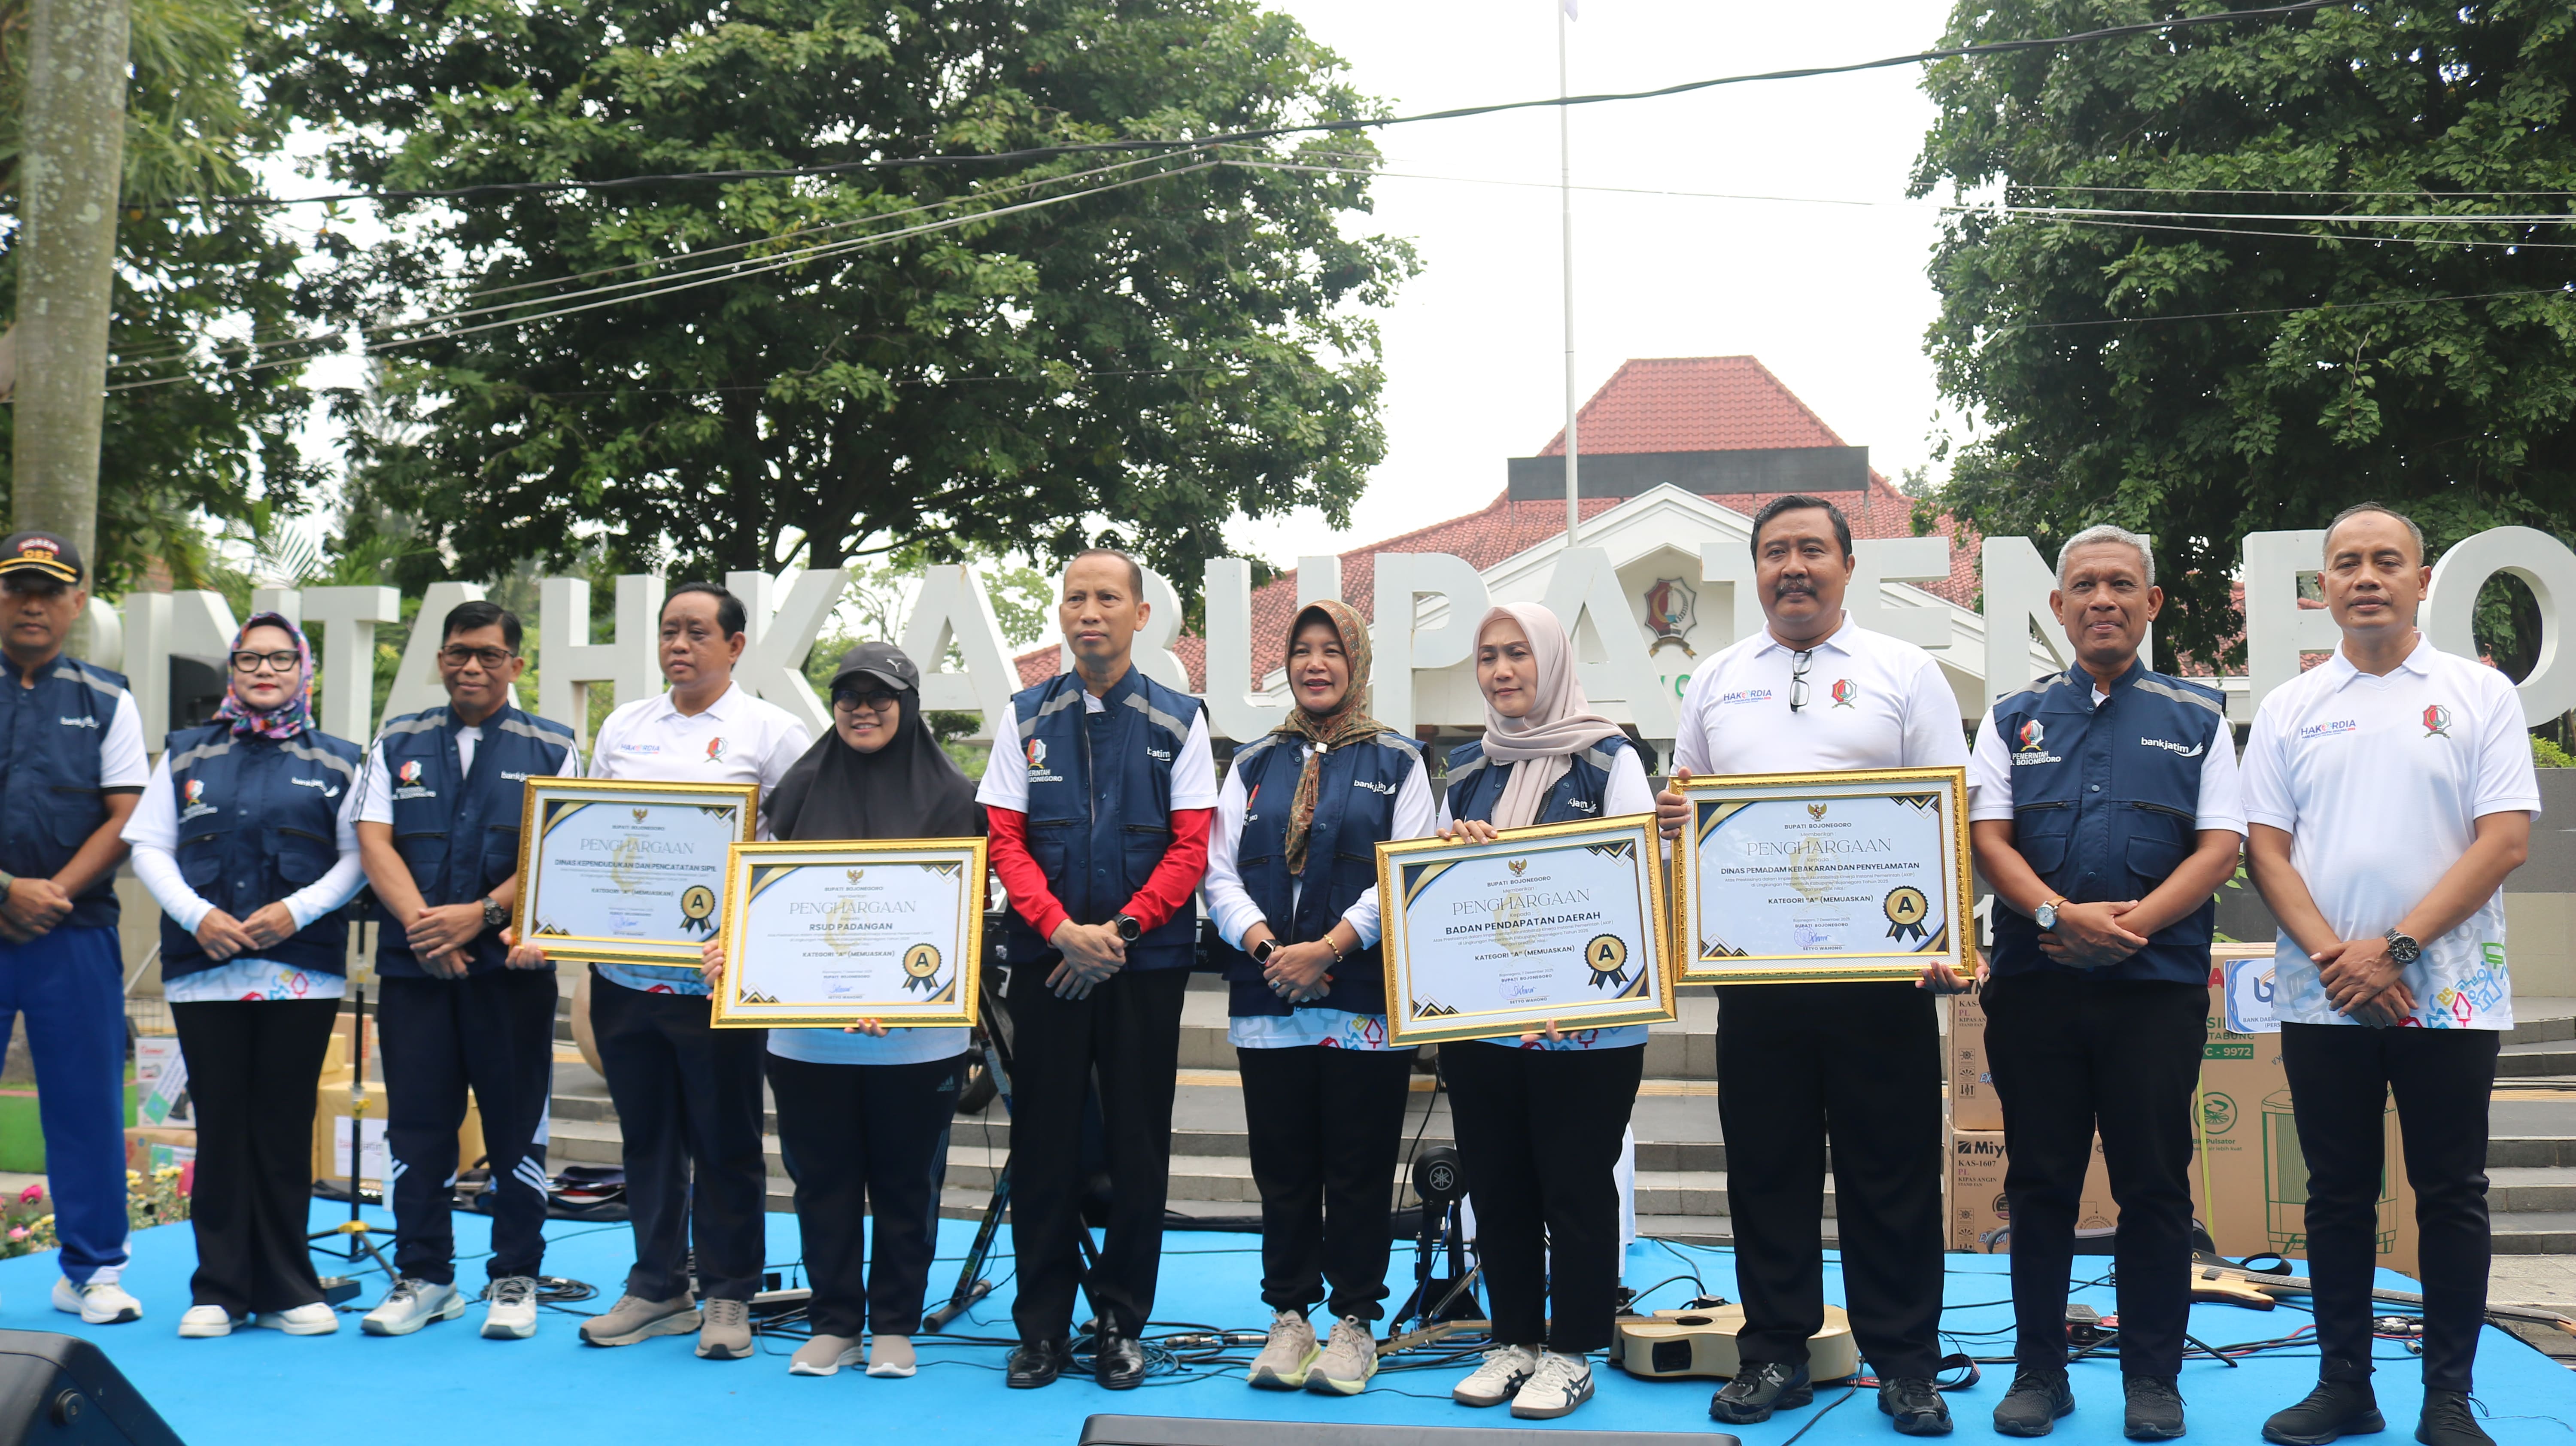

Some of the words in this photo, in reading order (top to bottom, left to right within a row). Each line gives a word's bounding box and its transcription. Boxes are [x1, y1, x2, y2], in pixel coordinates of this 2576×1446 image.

[2141, 737, 2189, 753] bankjatim
[2012, 750, 2048, 760] PEMERINTAH
[2017, 756, 2062, 766] BOJONEGORO
[580, 838, 694, 854] PENGHARGAAN
[1747, 838, 1892, 856] PENGHARGAAN
[577, 860, 634, 869] KEPENDUDUKAN
[652, 863, 700, 872] PENCATATAN
[1856, 862, 1920, 871] PENYELAMATAN
[1510, 875, 1551, 885] BOJONEGORO
[691, 894, 704, 909] A
[1452, 888, 1590, 916] PENGHARGAAN
[1820, 894, 1874, 904] (MEMUASKAN)
[1898, 896, 1915, 914] A
[789, 901, 916, 914] PENGHARGAAN
[809, 923, 835, 931] RSUD
[837, 923, 893, 931] PADANGAN
[1446, 924, 1482, 935] BADAN
[1485, 916, 1555, 931] PENDAPATAN
[1557, 911, 1601, 923] DAERAH
[914, 952, 929, 967] A
[1475, 953, 1509, 961] KATEGORI
[1524, 945, 1575, 957] (MEMUASKAN)
[1598, 944, 1616, 961] A
[2223, 1047, 2251, 1057] 9972
[2084, 1215, 2099, 1224] SWITCH
